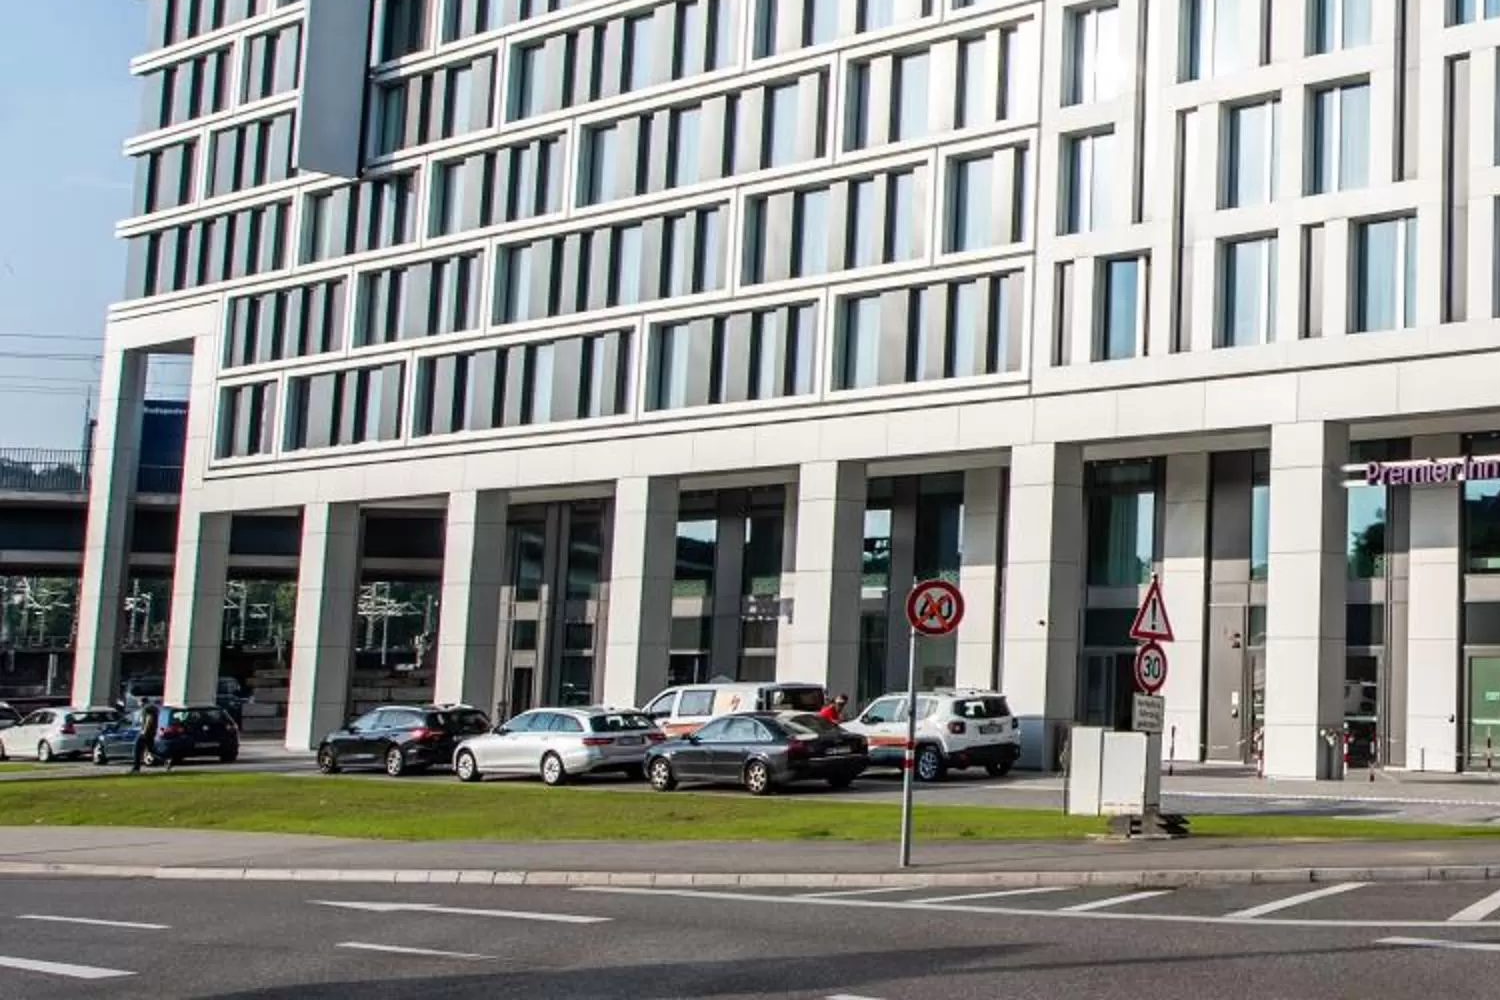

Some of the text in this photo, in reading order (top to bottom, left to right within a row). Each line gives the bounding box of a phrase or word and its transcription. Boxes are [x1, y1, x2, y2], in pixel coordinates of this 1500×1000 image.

[1366, 457, 1499, 484] Premier Inn
[1143, 655, 1161, 679] 30
